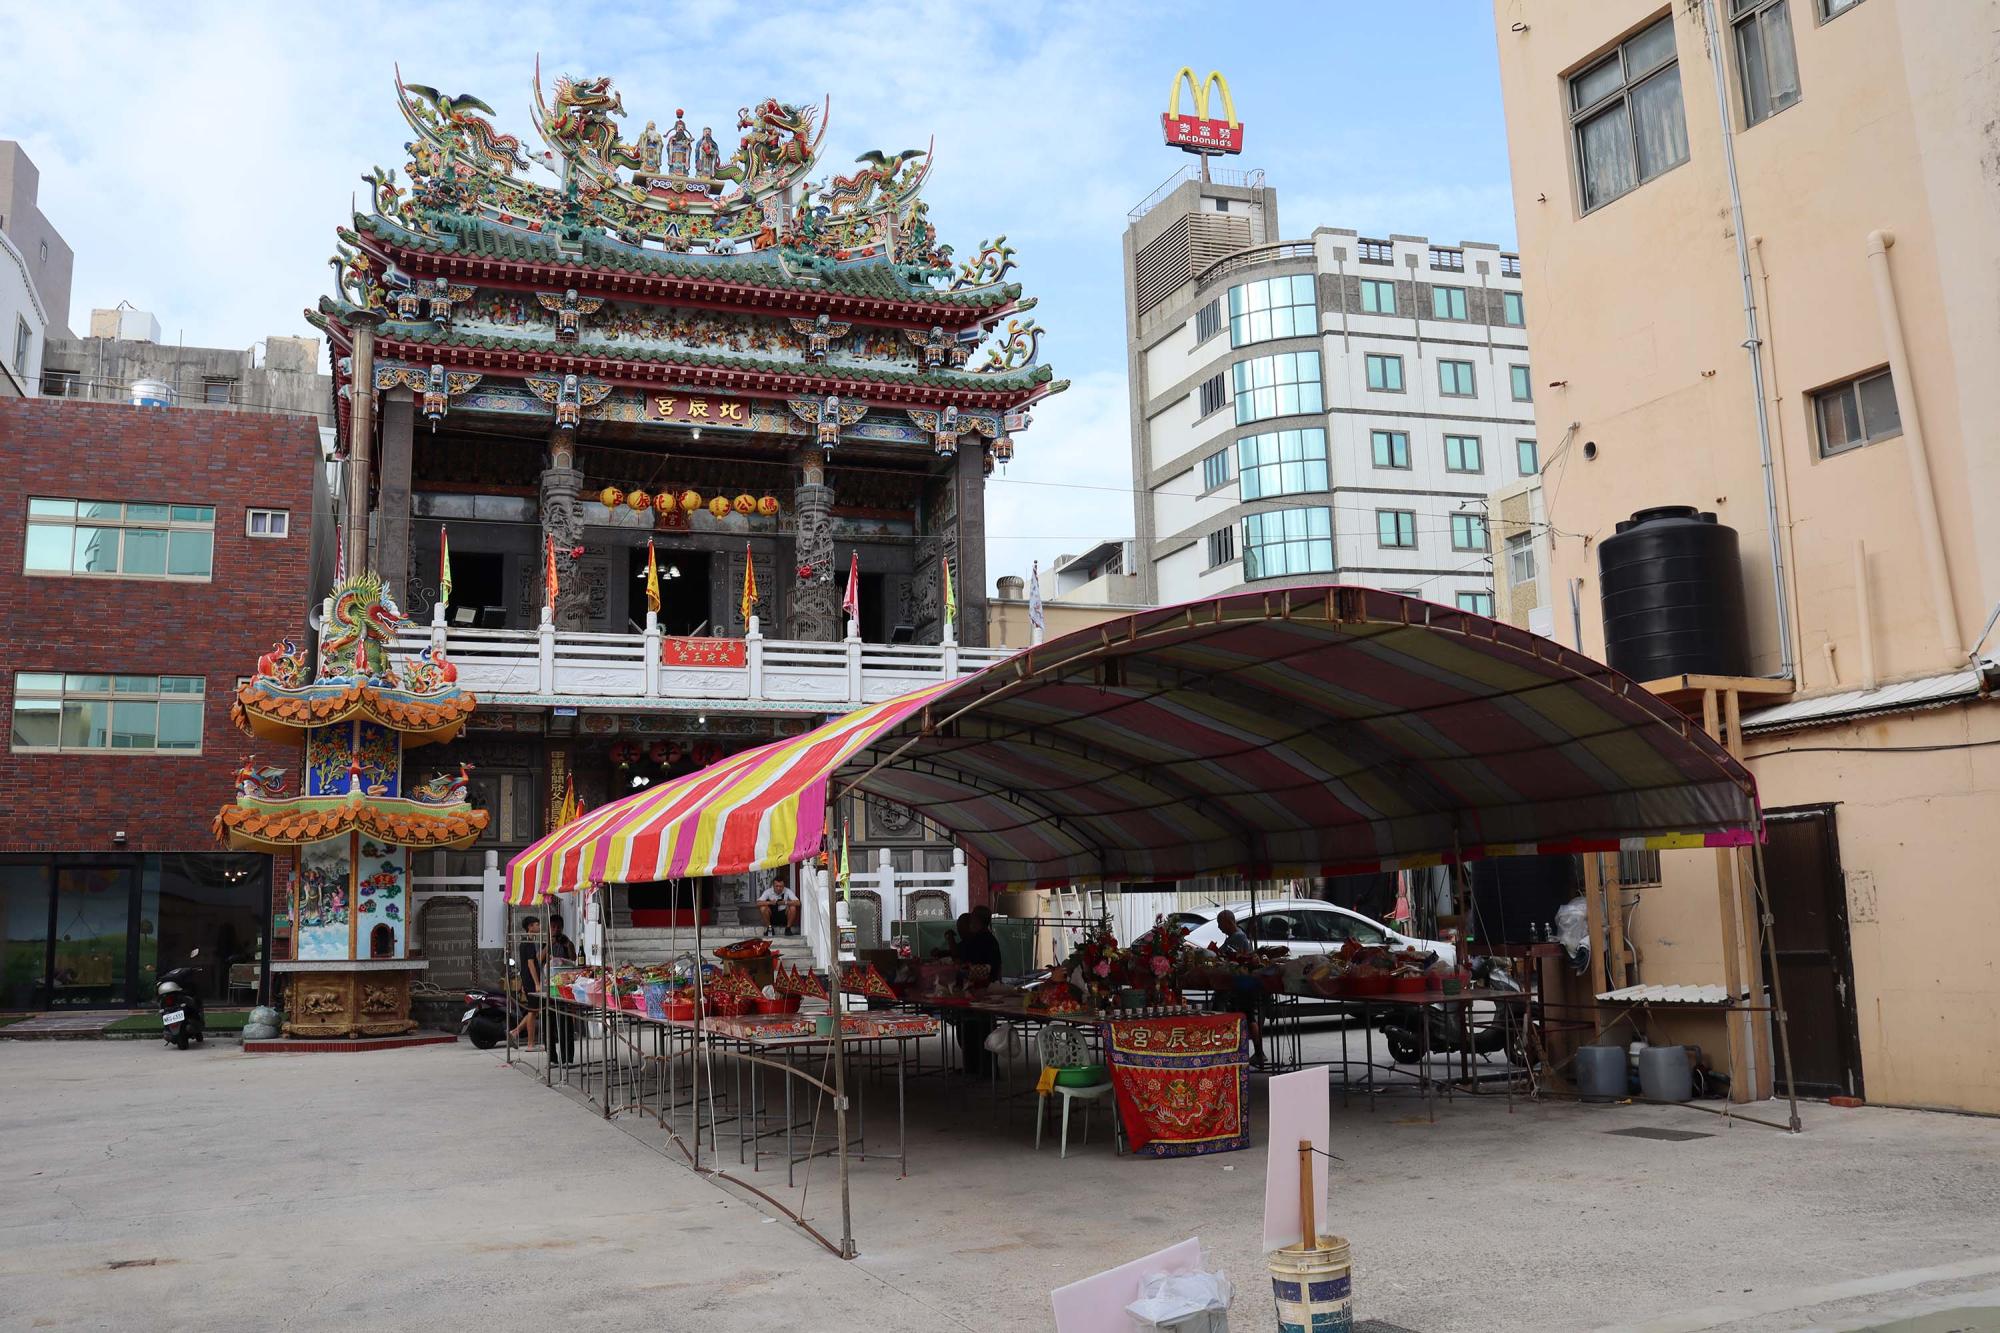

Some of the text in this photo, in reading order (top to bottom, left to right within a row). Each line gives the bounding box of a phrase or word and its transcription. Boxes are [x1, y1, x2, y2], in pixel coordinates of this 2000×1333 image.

[1178, 134, 1232, 147] McDonald's
[1130, 1026, 1222, 1048] 北辰宮
